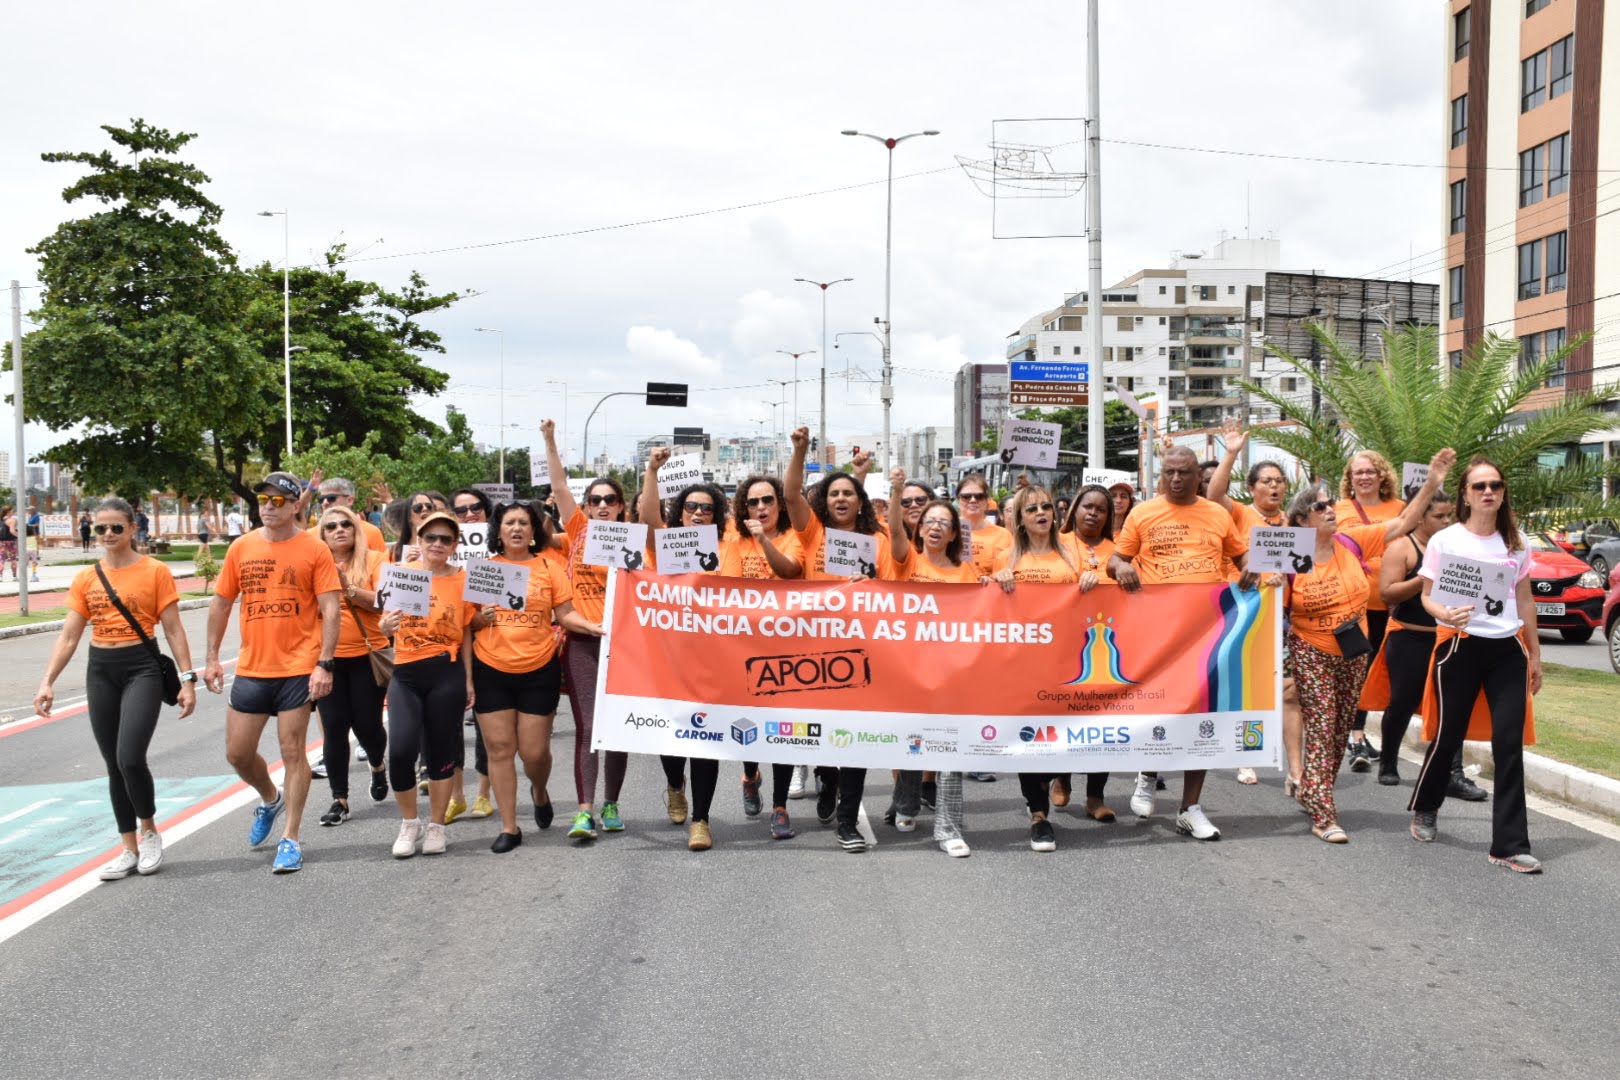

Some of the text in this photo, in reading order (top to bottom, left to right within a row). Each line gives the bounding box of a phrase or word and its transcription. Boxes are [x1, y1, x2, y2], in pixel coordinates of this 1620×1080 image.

[1012, 426, 1042, 436] #CHEGA
[1010, 435, 1054, 446] FEMINICÍDIO
[662, 460, 685, 470] GRUPO
[689, 469, 700, 478] DO
[599, 535, 628, 543] COLHER
[670, 540, 700, 549] COLHER
[834, 539, 858, 549] CHEGA
[828, 557, 856, 566] ASSÉDIO
[480, 565, 496, 573] NÃO
[1162, 564, 1175, 574] EU
[1456, 562, 1474, 573] NÃO
[392, 571, 409, 580] NEM
[410, 574, 430, 583] UMA
[470, 571, 504, 581] VIOLÊNCIA
[1442, 568, 1483, 583] VIOLÊNCIA
[395, 582, 423, 592] MENOS
[468, 578, 495, 588] CONTRA
[1440, 576, 1471, 589] CONTRA
[469, 584, 502, 595] MULHERES
[1439, 584, 1479, 598] MULHERES
[636, 581, 939, 615] CAMINHADA PELO FIM DA
[1303, 598, 1333, 608] CONTRA
[258, 602, 292, 614] APOIO
[506, 614, 540, 624] APOIO
[1319, 617, 1332, 627] EU
[635, 606, 1053, 644] VIOLÊNCIA CONTRA AS MULHERES
[756, 656, 854, 687] APOIO
[1037, 689, 1165, 703] Grupo Mulheres do Brasil
[1068, 702, 1134, 711] Núcleo Vitória
[624, 712, 670, 730] Apoio:
[766, 722, 820, 736] LUAN
[1020, 725, 1058, 742] OAB
[674, 729, 724, 742] CARONE
[857, 732, 898, 744] Mariah
[1066, 726, 1130, 744] MPES
